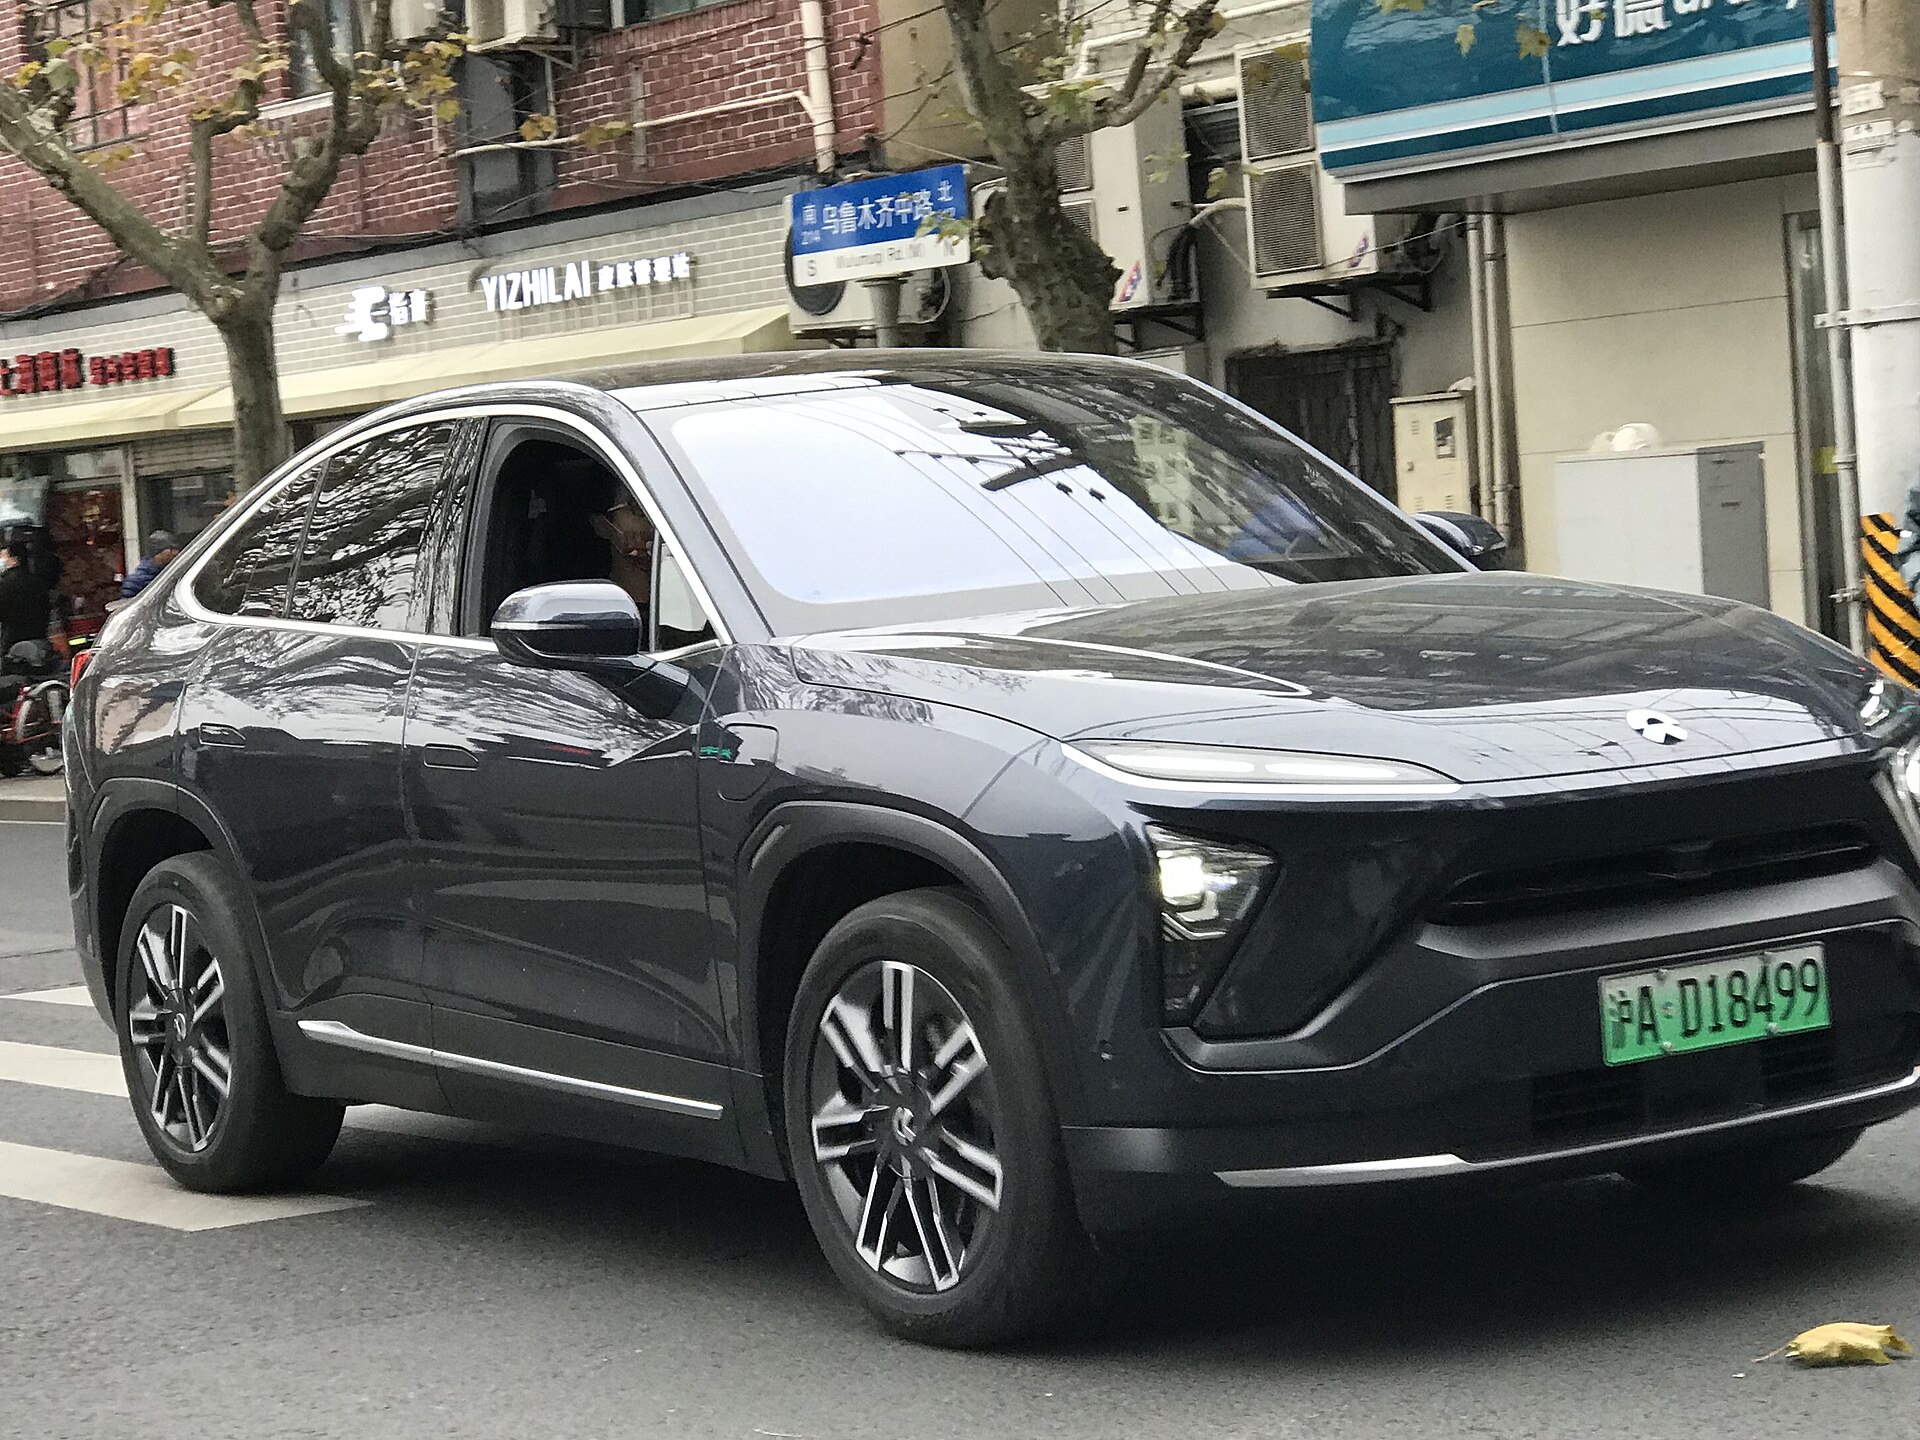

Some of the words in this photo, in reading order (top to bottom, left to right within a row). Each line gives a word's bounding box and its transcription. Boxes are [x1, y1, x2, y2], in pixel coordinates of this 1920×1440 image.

[802, 203, 817, 226] 南
[822, 188, 933, 235] 乌鲁木齐中路
[937, 179, 954, 202] 北
[478, 259, 592, 313] YIZHILAI
[806, 258, 818, 277] S
